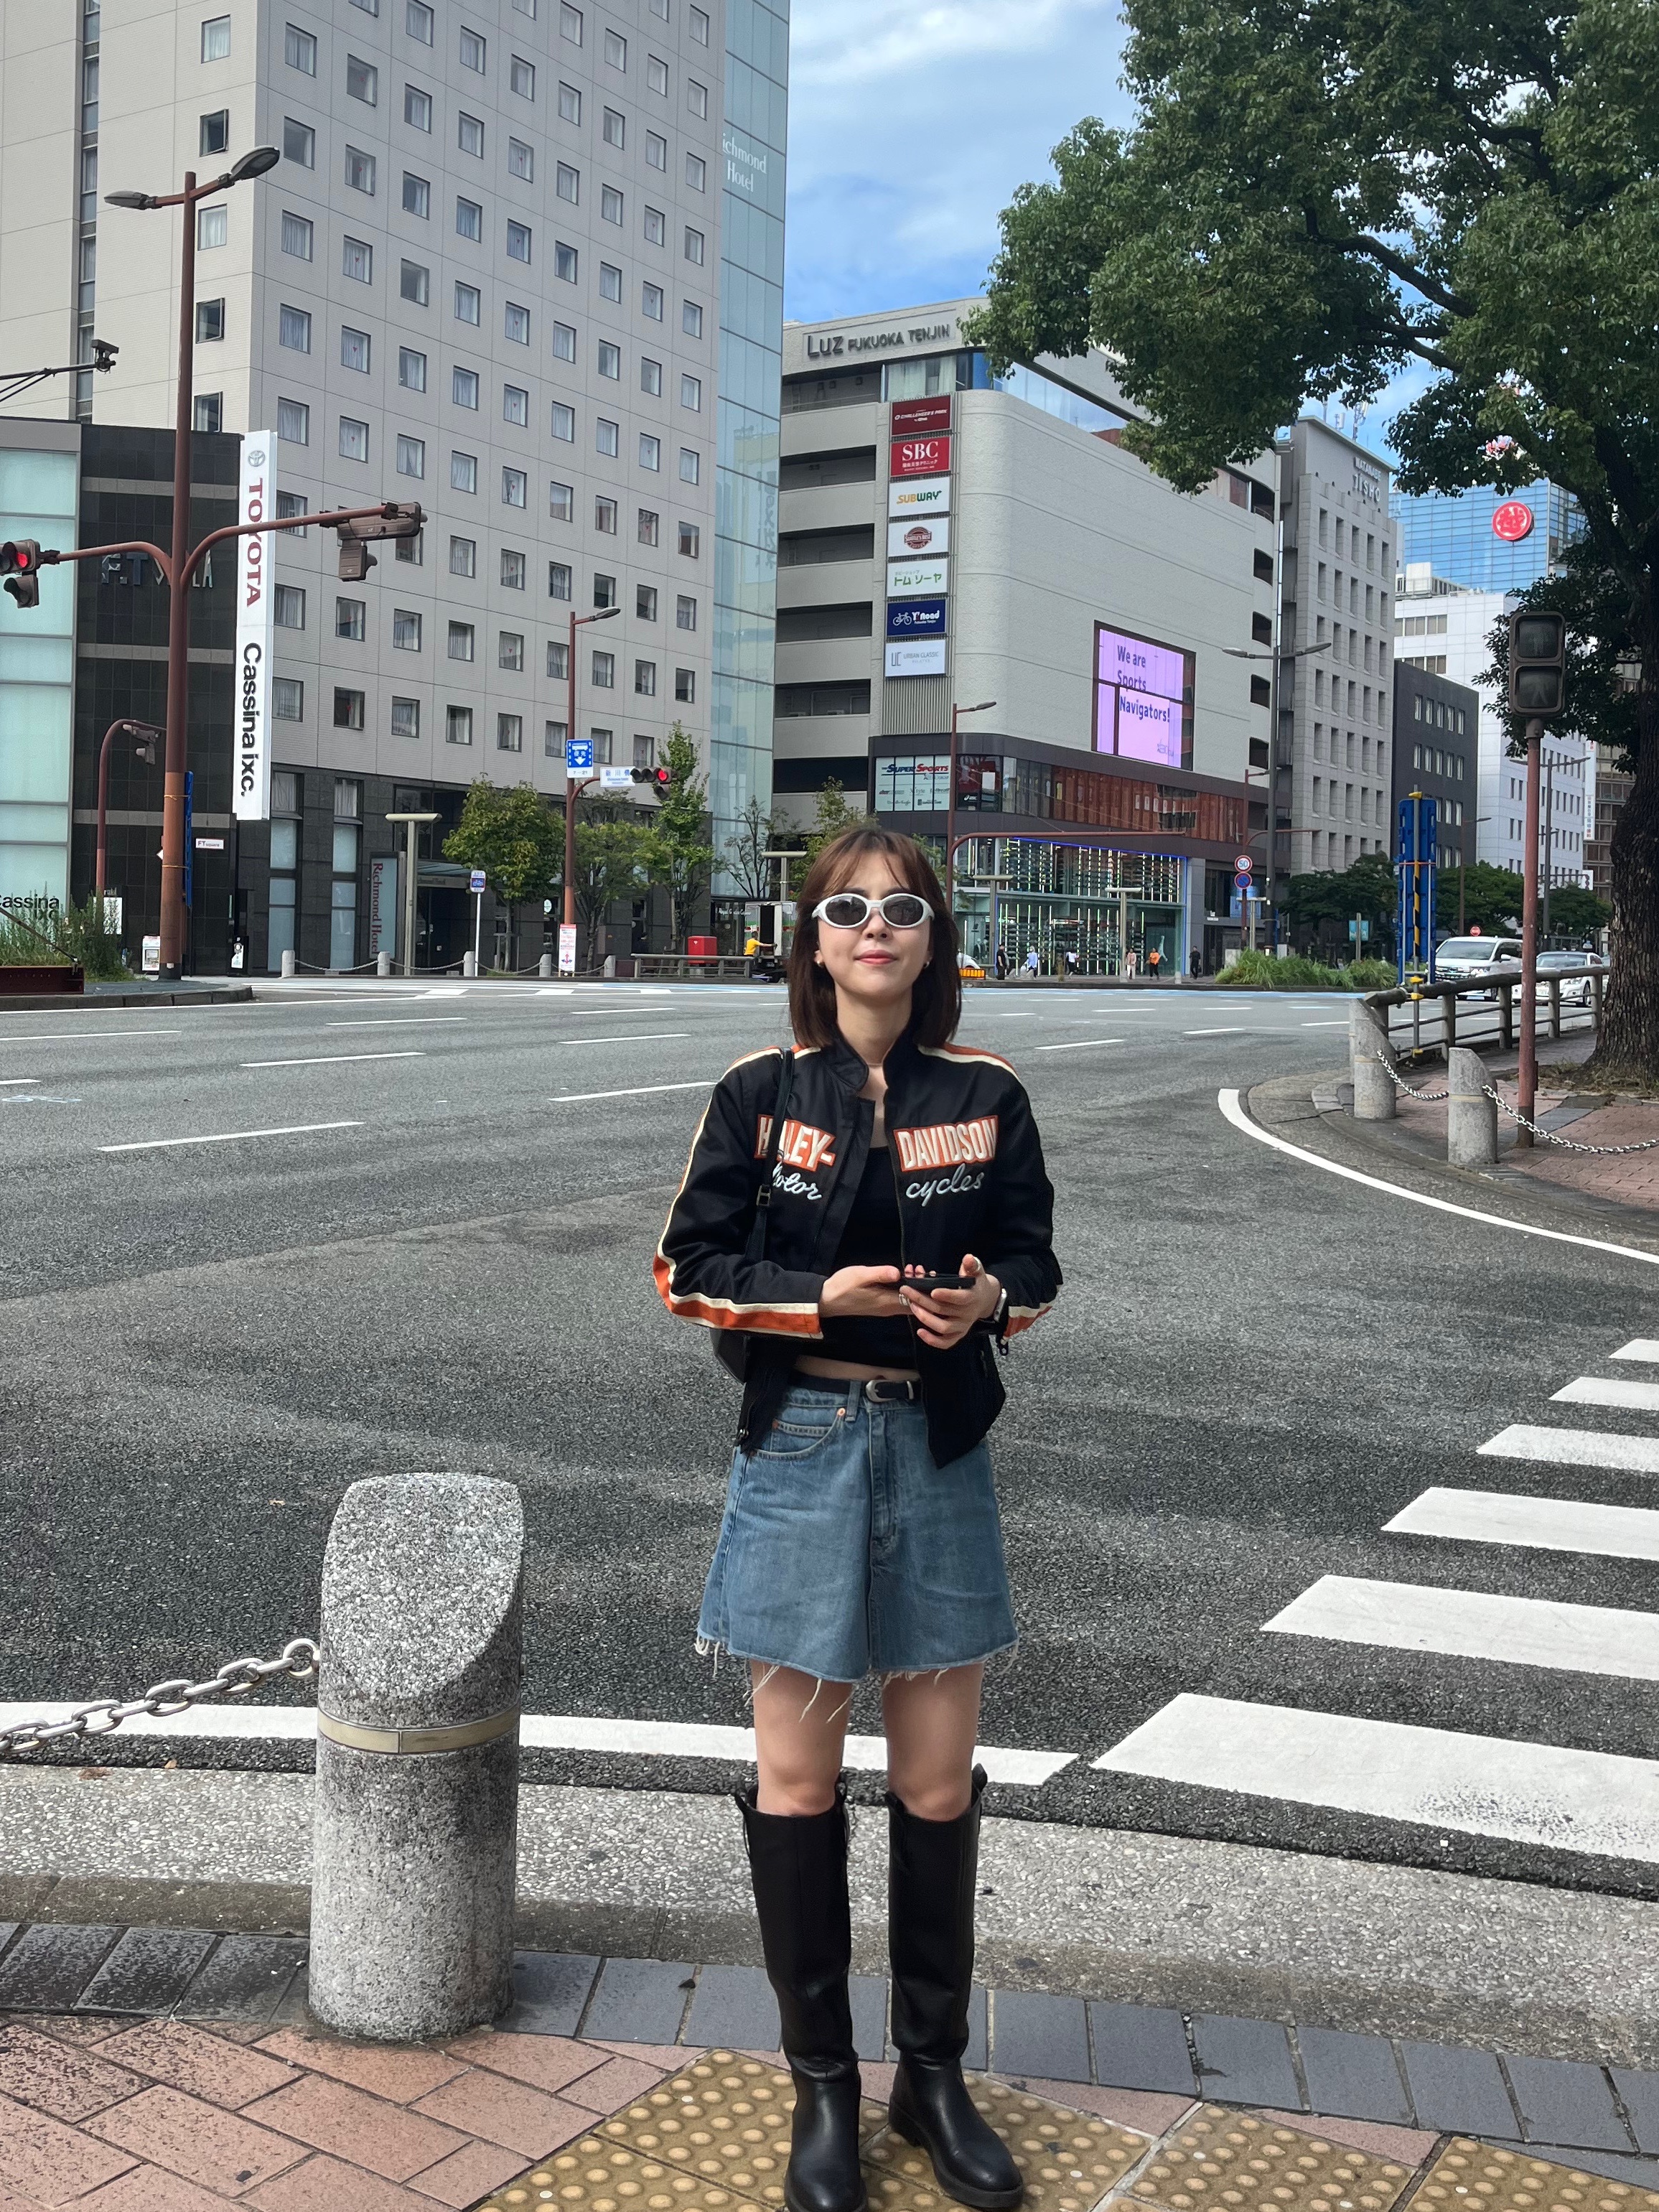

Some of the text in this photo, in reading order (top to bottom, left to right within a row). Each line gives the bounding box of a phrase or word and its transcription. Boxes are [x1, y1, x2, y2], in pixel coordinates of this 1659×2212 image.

[722, 133, 767, 174] ichmond
[726, 159, 754, 192] Hotel
[848, 331, 905, 352] FUKUOKA
[907, 324, 950, 343] TENJIN
[902, 441, 939, 462] SBC
[897, 490, 942, 505] SUBWAY
[1117, 645, 1146, 668] We are
[1117, 670, 1146, 692] Sports
[242, 643, 262, 749] Cassina
[1119, 696, 1170, 723] Navigators!
[887, 764, 916, 773] SUPER
[916, 764, 949, 773] SPORTS
[0, 894, 60, 909] assina
[371, 863, 383, 955] Richmond Hotel
[757, 1116, 997, 1170] HLEY- DAVIDSON
[906, 1163, 985, 1207] cycles
